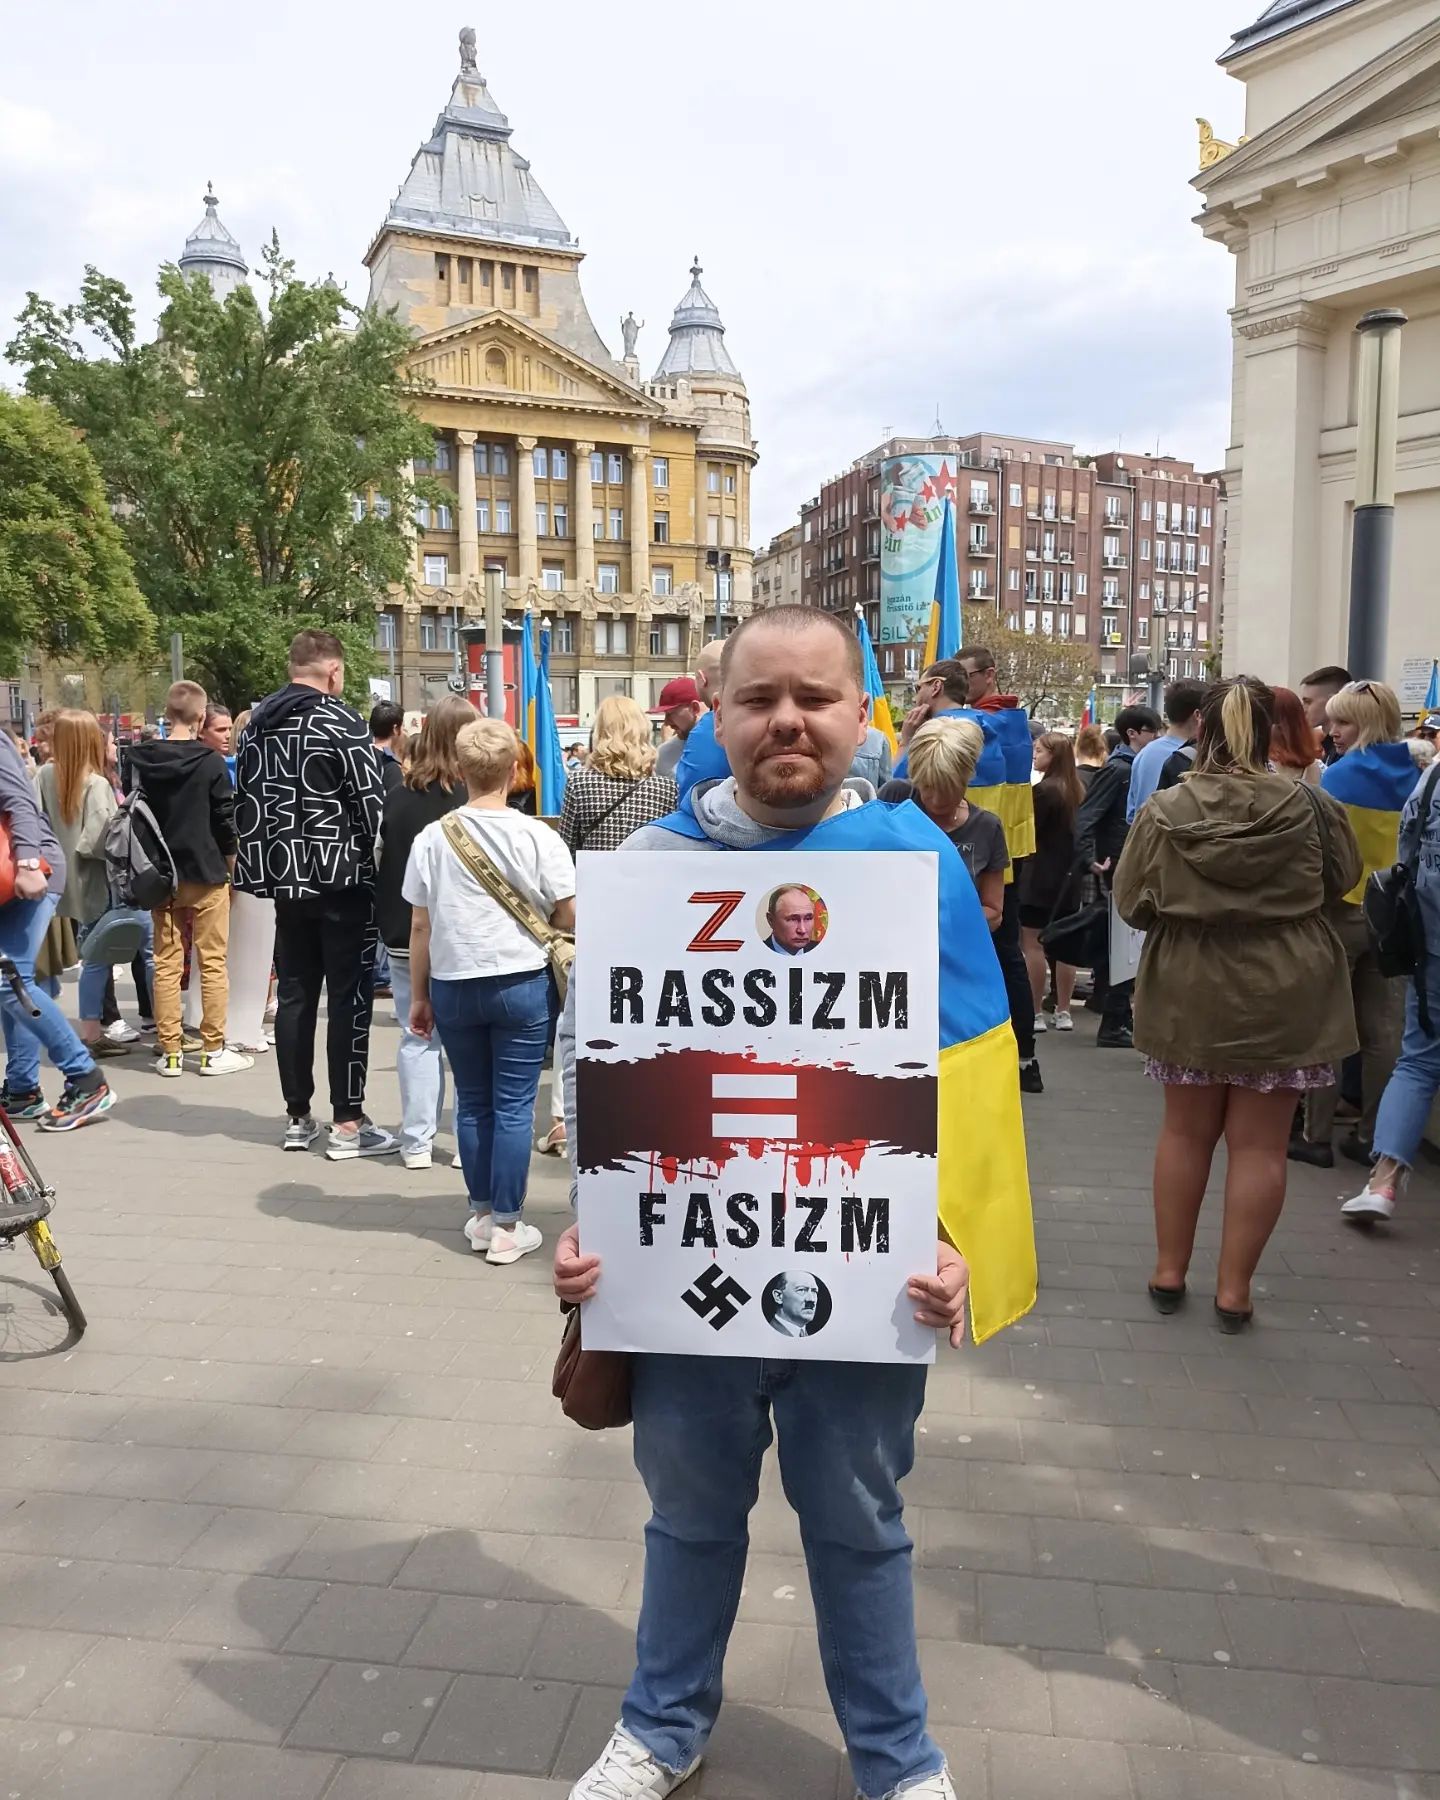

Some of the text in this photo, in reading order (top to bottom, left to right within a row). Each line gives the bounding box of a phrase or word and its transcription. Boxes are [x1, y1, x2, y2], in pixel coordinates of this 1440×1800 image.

[234, 839, 343, 887] NOW
[686, 891, 746, 952] Z
[609, 966, 909, 1030] RASSIZM
[638, 1193, 890, 1254] FASIZM
